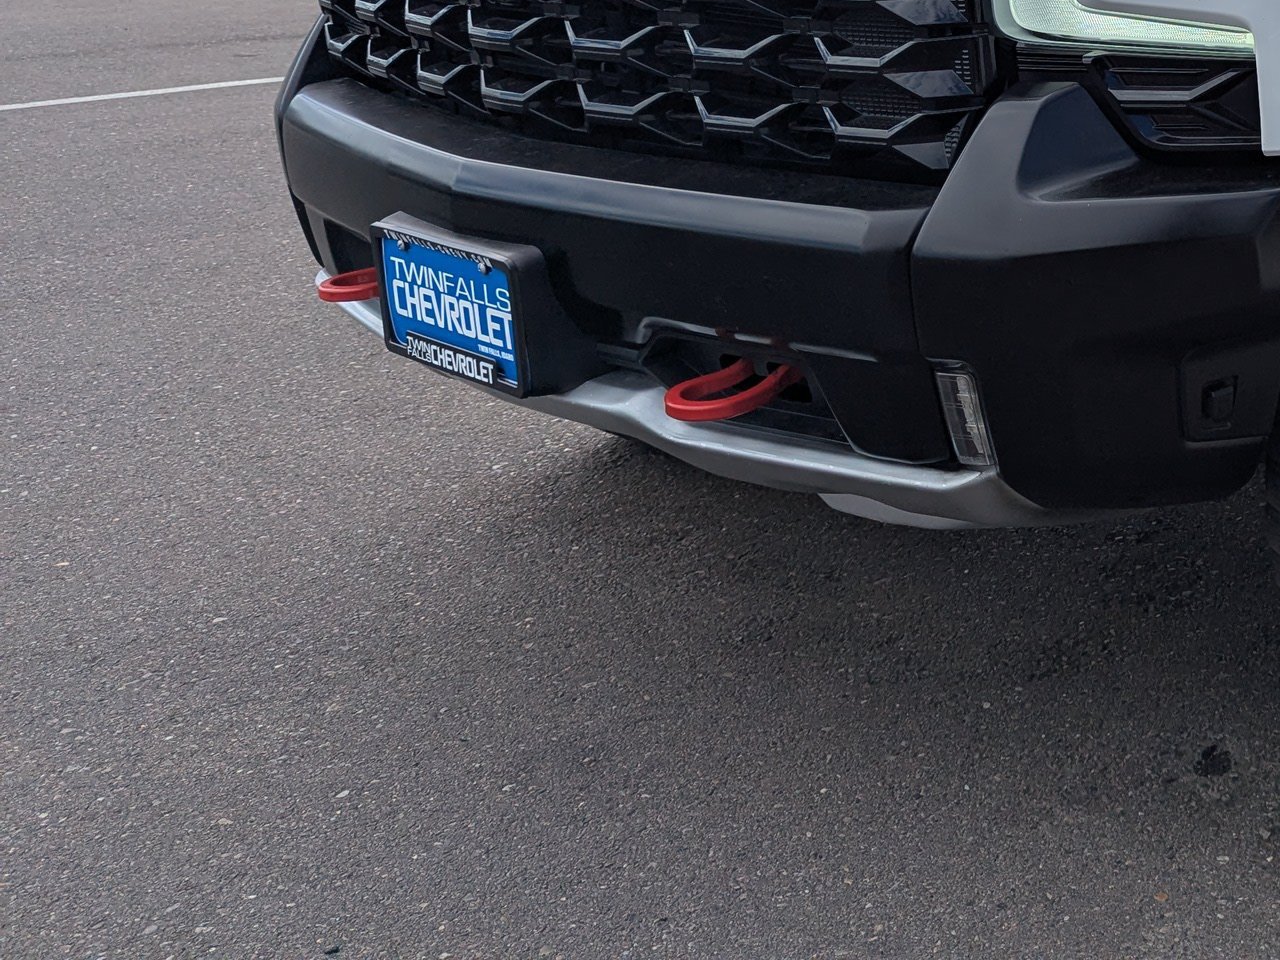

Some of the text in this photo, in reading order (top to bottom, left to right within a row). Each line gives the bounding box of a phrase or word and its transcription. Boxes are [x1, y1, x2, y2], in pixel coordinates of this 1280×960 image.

[393, 279, 513, 350] CHEVROLET
[406, 336, 431, 353] TWIN
[407, 347, 432, 363] FALLS
[430, 345, 494, 384] CHEVROLET
